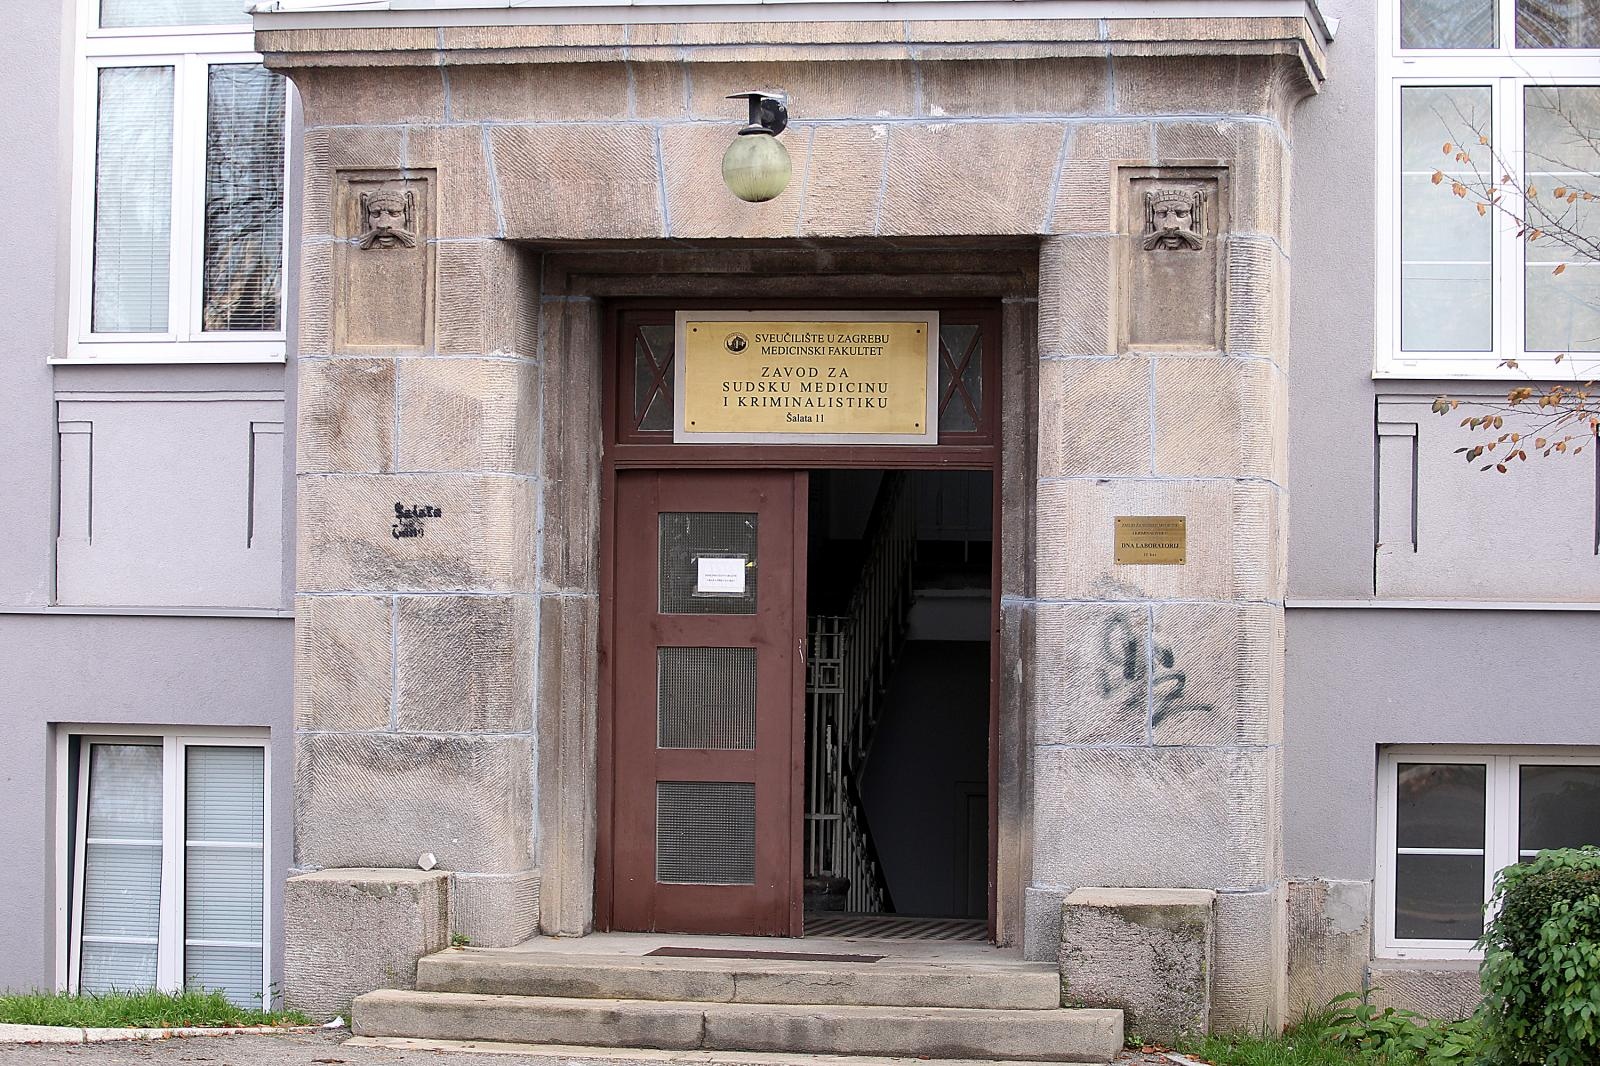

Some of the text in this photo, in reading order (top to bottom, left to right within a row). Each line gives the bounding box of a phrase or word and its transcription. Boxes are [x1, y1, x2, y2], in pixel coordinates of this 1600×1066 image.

[755, 332, 824, 344] SVEUČILIŠTE
[827, 334, 836, 344] U
[837, 334, 890, 344] ZAGREBU
[761, 346, 884, 356] MEDICINSKI FAKULTET
[761, 367, 849, 378] ZAVOD ZA
[722, 382, 888, 393] SUDSKU MEDICINU
[723, 397, 888, 408] I KRIMINALISTIKU
[786, 412, 824, 423] Šalata 11
